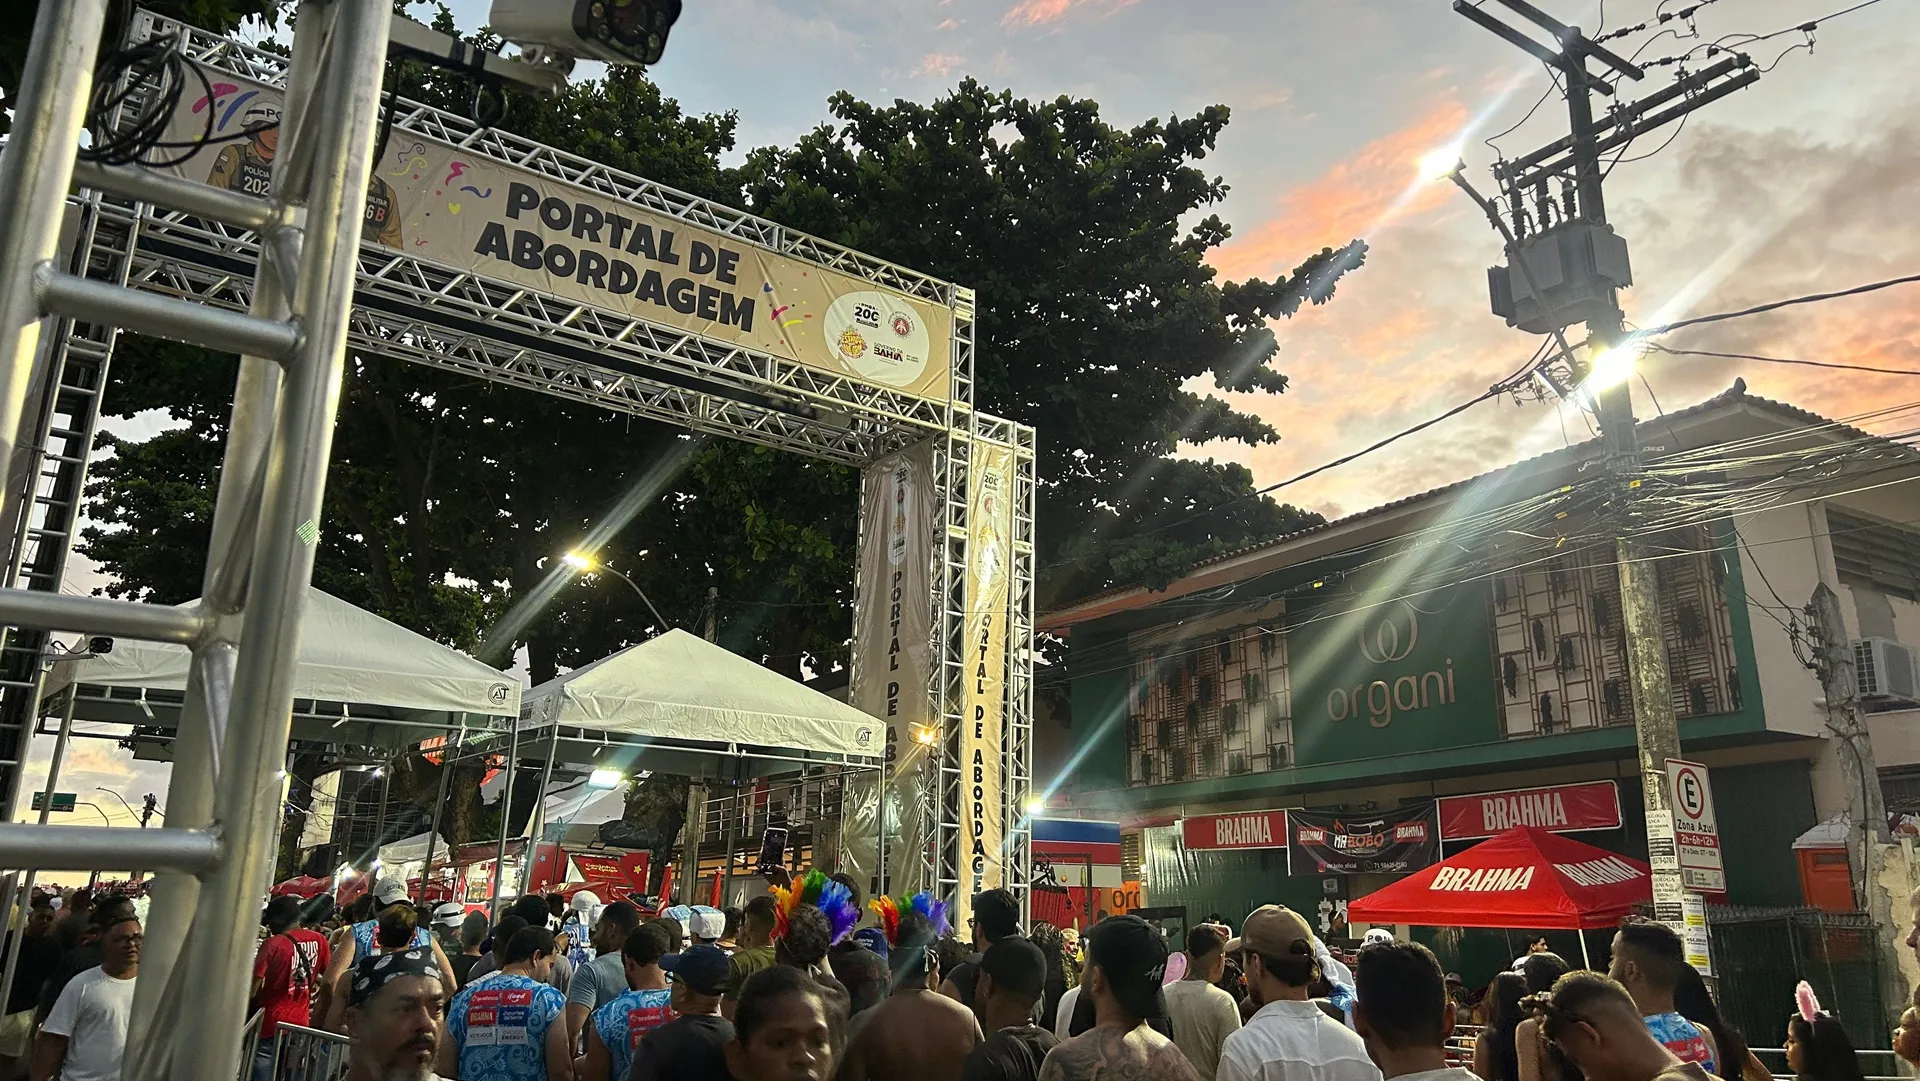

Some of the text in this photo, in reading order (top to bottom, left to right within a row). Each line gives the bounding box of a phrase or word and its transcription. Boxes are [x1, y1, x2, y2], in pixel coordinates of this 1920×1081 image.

[506, 181, 740, 286] PORTAL DE
[473, 221, 756, 334] ABORDAGEM
[873, 346, 903, 363] BAHIA
[887, 570, 903, 672] PORTAL
[886, 682, 900, 716] DE
[1326, 657, 1456, 728] organi
[975, 704, 985, 739] DE
[1684, 776, 1698, 808] E
[1482, 792, 1568, 831] BRAHMA
[1677, 818, 1695, 831] Zona
[1215, 814, 1273, 845] BRAHMA
[1299, 830, 1323, 841] BRAHMA
[1396, 825, 1424, 838] BRAHMA
[1680, 833, 1715, 847] 2h-6h-12h
[1429, 866, 1536, 892] BRAHMA
[1552, 855, 1646, 887] BRAHMA
